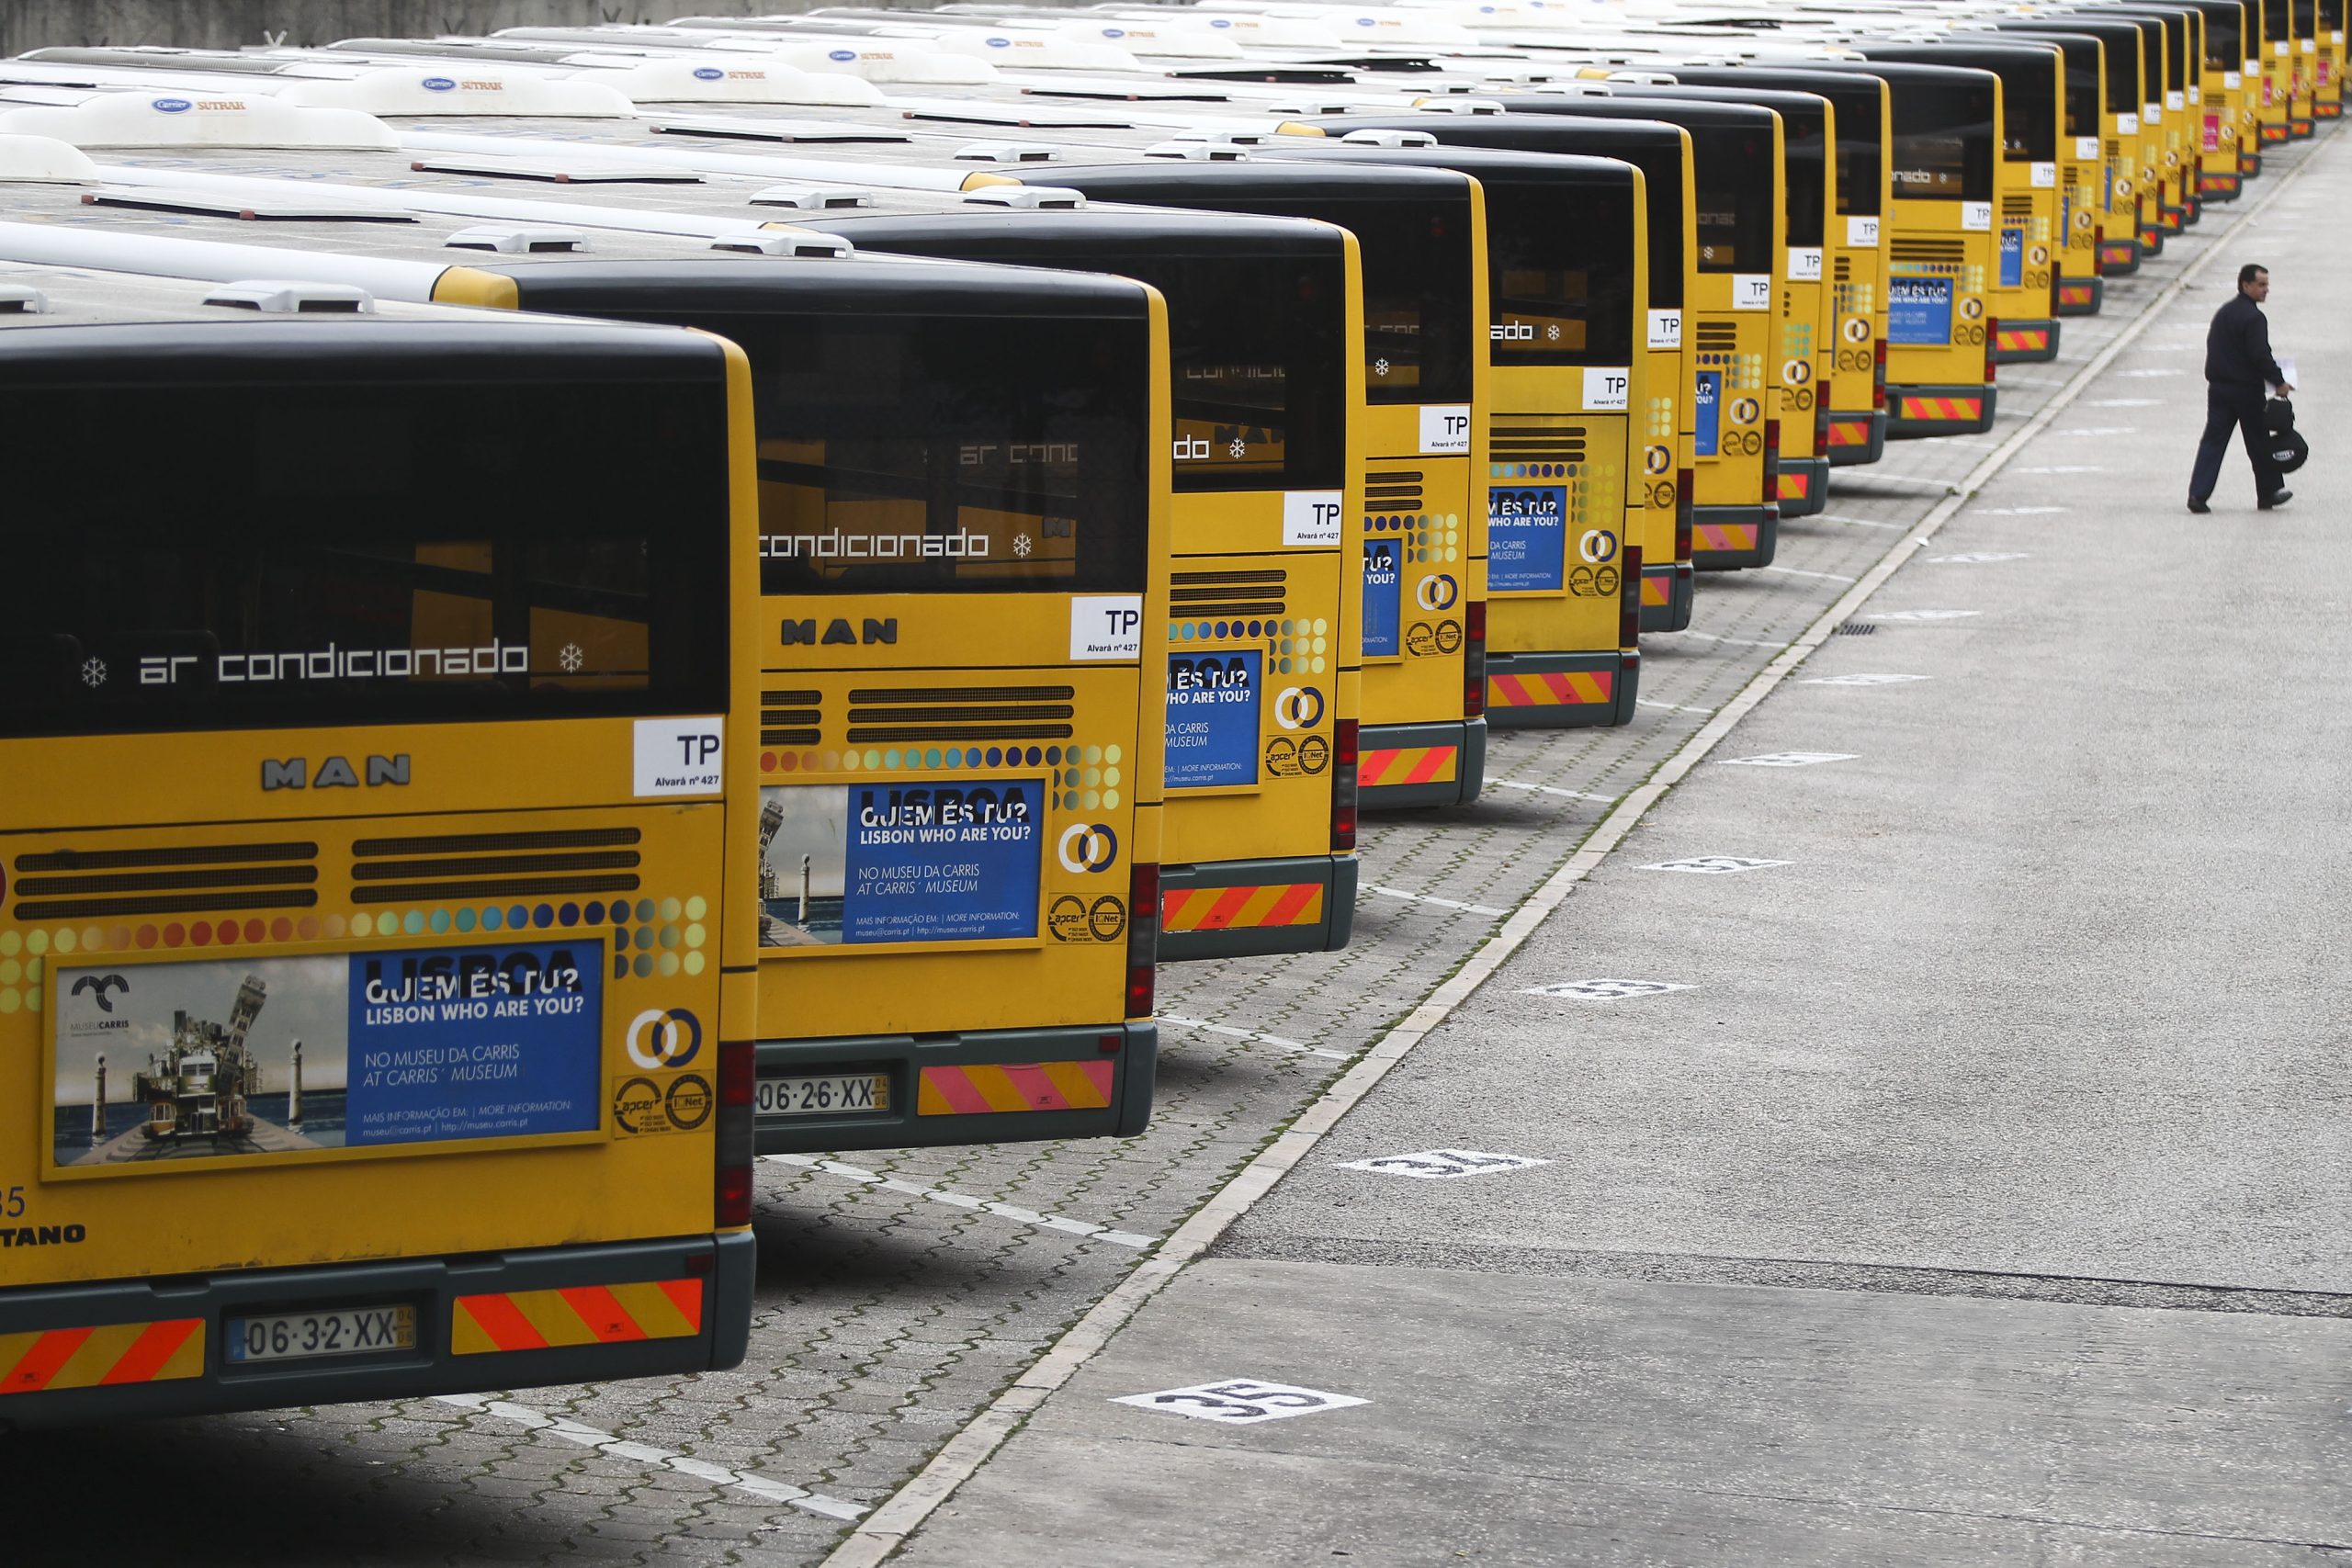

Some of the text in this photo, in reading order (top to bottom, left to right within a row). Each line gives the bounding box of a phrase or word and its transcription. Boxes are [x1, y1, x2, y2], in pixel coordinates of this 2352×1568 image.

[461, 81, 503, 91] SUTRAK
[198, 101, 246, 111] SUTRAK
[1863, 223, 1877, 235] TP
[1804, 255, 1820, 267] TP
[1751, 282, 1768, 296] TP
[1660, 318, 1679, 333] TP
[1605, 378, 1626, 394] TP
[1443, 416, 1468, 434] TP
[1312, 504, 1340, 525] TP
[1488, 516, 1559, 526] WHO ARE YOU?
[1490, 540, 1527, 550] DA CARRIS
[1491, 551, 1525, 560] MUSEUM
[1366, 572, 1395, 584] YOU?
[1105, 610, 1139, 635] TP
[781, 618, 898, 646] MAN
[1087, 644, 1112, 652] Alvará
[1123, 643, 1138, 651] 427
[140, 637, 528, 684] ar condicionado
[1192, 691, 1215, 704] ARE
[1218, 690, 1250, 703] YOU?
[1178, 722, 1209, 734] CARRIS
[677, 735, 719, 765] TP
[1165, 736, 1207, 748] MUSEUM
[262, 754, 411, 791] MAN
[655, 776, 686, 787] Alvará
[701, 774, 719, 785] 427
[860, 806, 935, 828] QUEM
[860, 825, 1032, 845] LISBON WHO ARE YOU?
[858, 863, 980, 880] NO MUSEU DA CARRIS
[856, 883, 872, 896] AT
[925, 879, 978, 893] MUSEUM
[875, 913, 924, 925] INFORMAÇÃO
[945, 913, 967, 922] MORE
[968, 911, 1020, 921] INFORMATION:
[366, 976, 459, 1005] QUEM
[367, 996, 584, 1025] LISBON WHO ARE YOU?
[365, 1043, 520, 1068] NO MUSEU DA CARRIS
[363, 1070, 382, 1087] AT
[450, 1064, 517, 1081] MUSEUM
[363, 1113, 385, 1122] MAIS
[387, 1106, 450, 1122] INFORMAÇÃO
[478, 1103, 505, 1115] MORE
[0, 1186, 25, 1218] 5
[0, 1224, 85, 1247] TANO
[1155, 1383, 1328, 1417] 35
